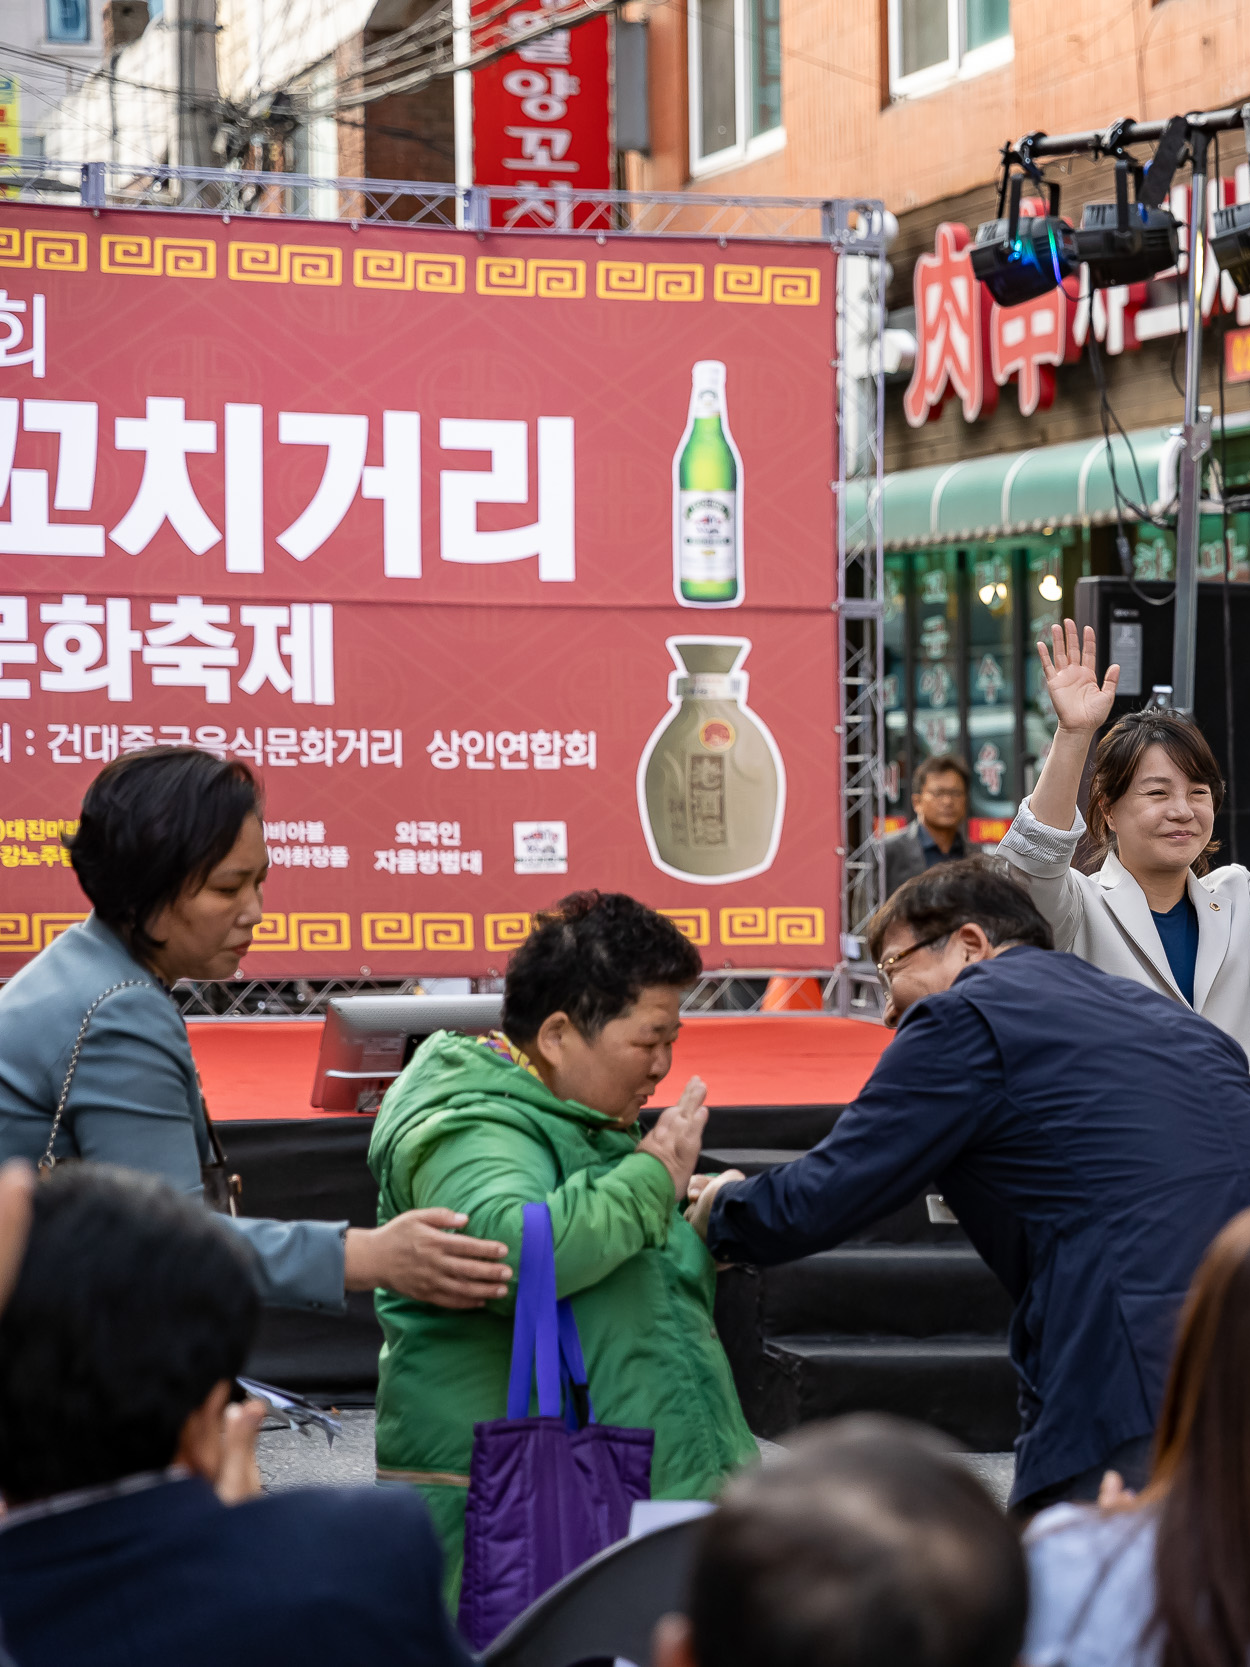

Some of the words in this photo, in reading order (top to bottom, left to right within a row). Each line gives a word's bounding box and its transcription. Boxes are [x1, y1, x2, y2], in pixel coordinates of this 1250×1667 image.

[425, 729, 597, 770] 상인연합회
[395, 820, 462, 847] 외국인
[374, 848, 483, 876] 자율방범대
